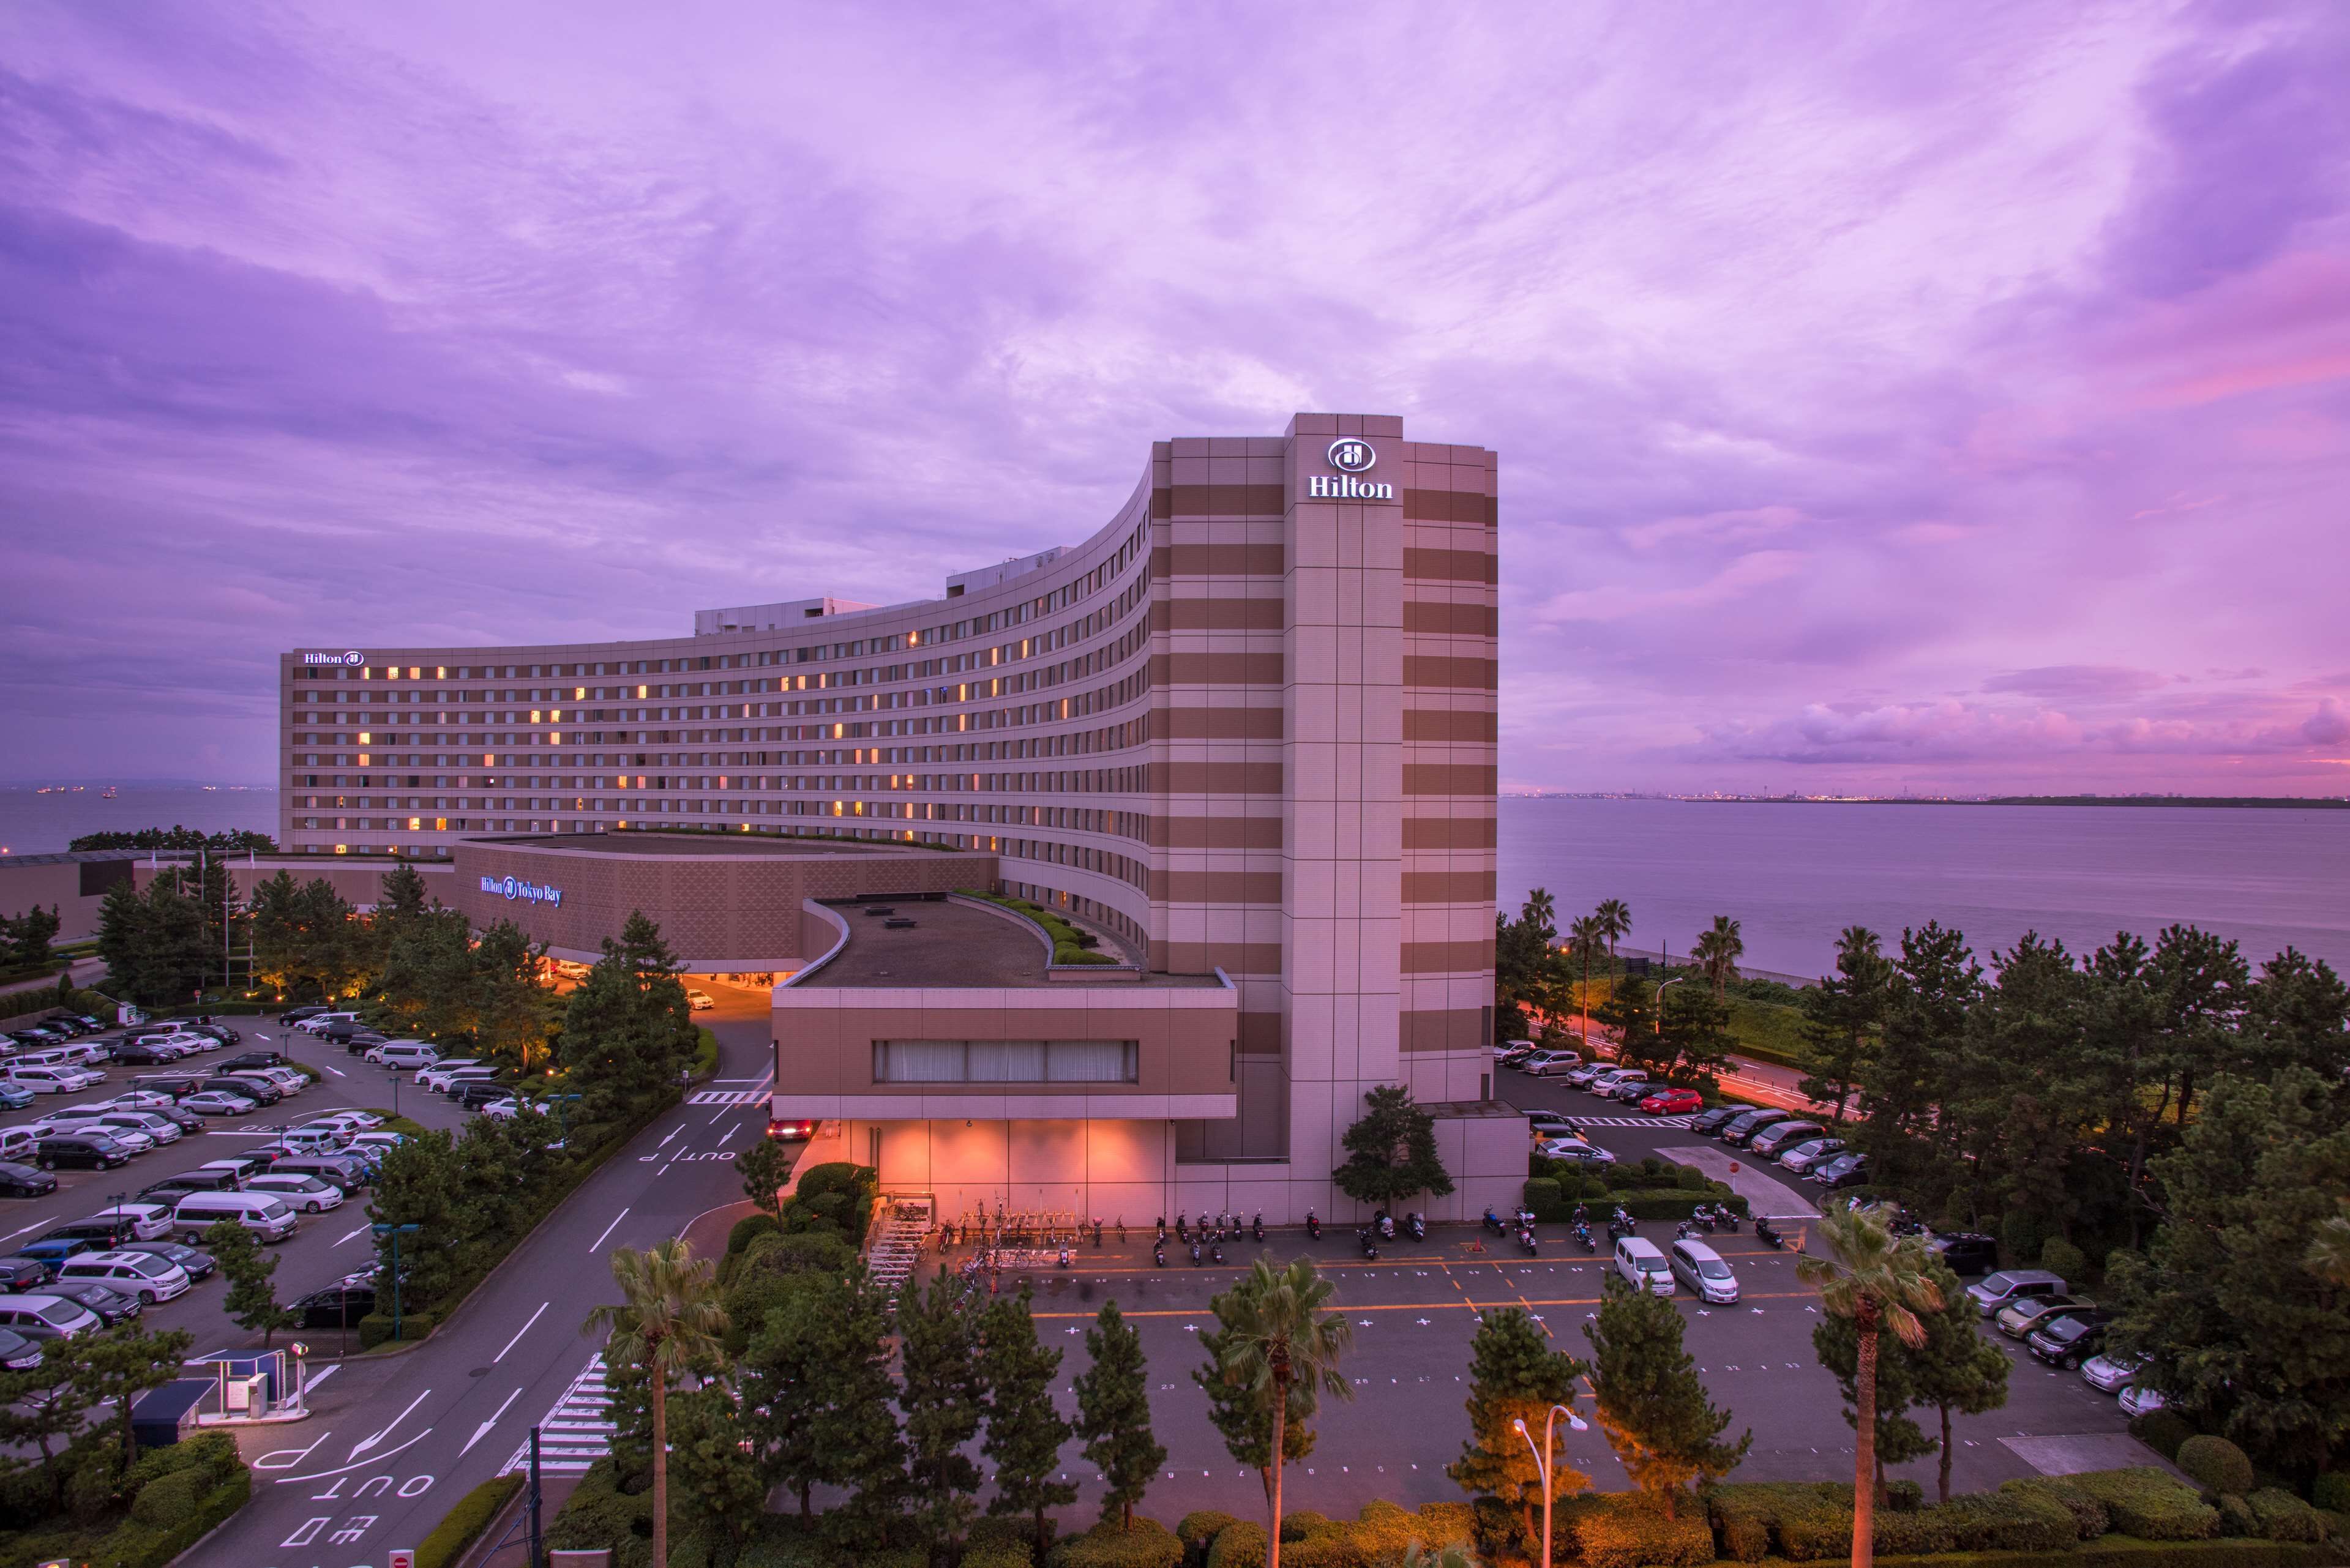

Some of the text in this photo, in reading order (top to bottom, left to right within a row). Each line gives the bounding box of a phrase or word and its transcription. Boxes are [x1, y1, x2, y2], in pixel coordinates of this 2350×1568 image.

[1309, 475, 1393, 499] Hilton
[305, 653, 342, 663] Hilton
[481, 876, 561, 908] Hilton Tokyo Bay
[681, 1152, 736, 1160] OUT
[253, 1432, 331, 1469] P
[310, 1475, 435, 1499] OUT
